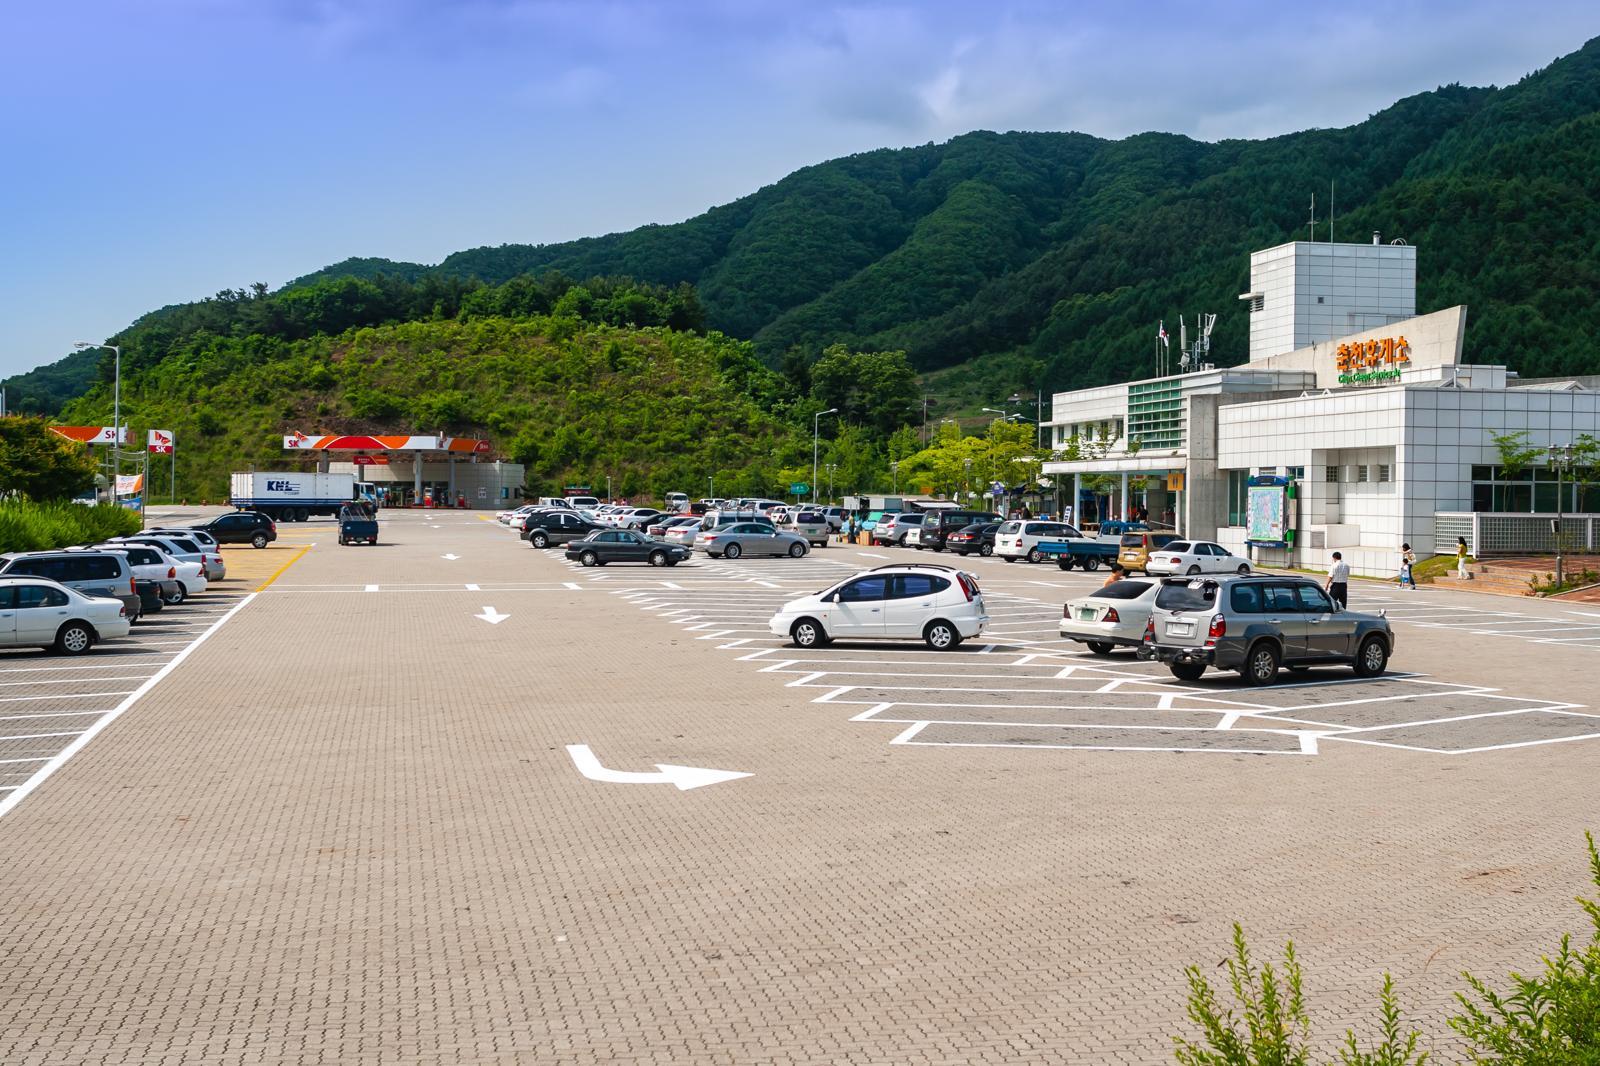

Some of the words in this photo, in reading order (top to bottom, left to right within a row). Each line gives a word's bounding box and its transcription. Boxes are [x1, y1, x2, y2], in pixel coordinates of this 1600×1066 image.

[1337, 336, 1409, 372] 춘천휴게소
[288, 439, 300, 448] SK
[155, 445, 166, 453] SK
